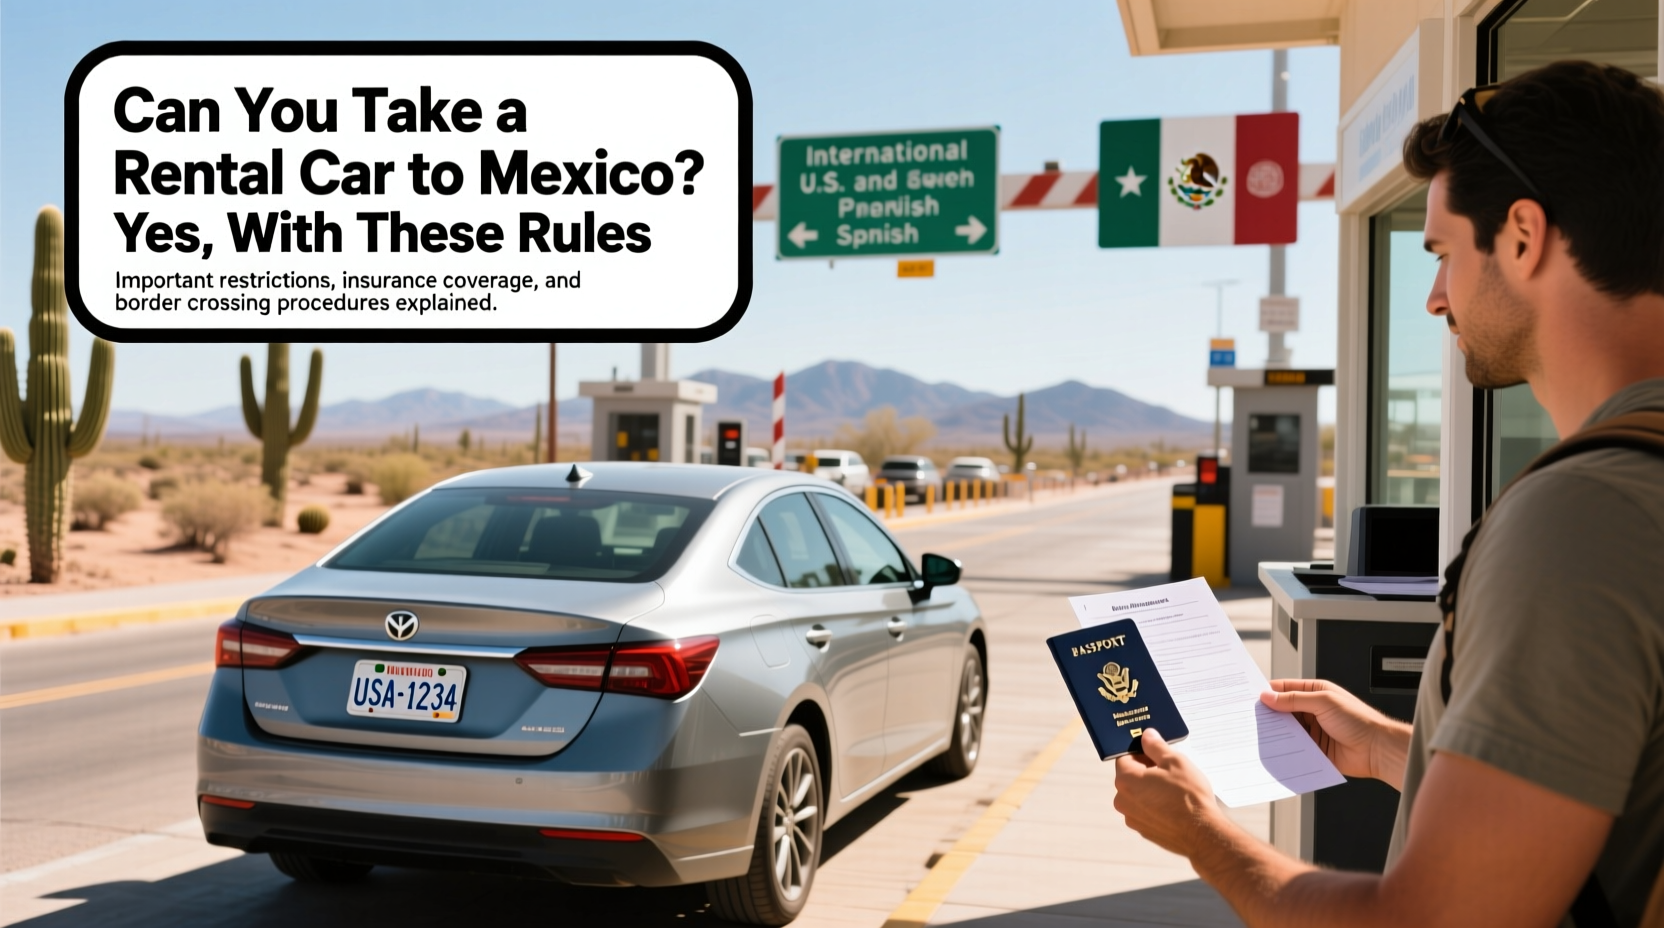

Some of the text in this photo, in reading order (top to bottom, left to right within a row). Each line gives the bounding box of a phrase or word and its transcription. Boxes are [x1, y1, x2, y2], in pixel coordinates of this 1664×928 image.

[806, 139, 968, 167] International
[800, 171, 846, 194] U.S.
[853, 169, 898, 192] and
[353, 677, 457, 711] USA-1234
